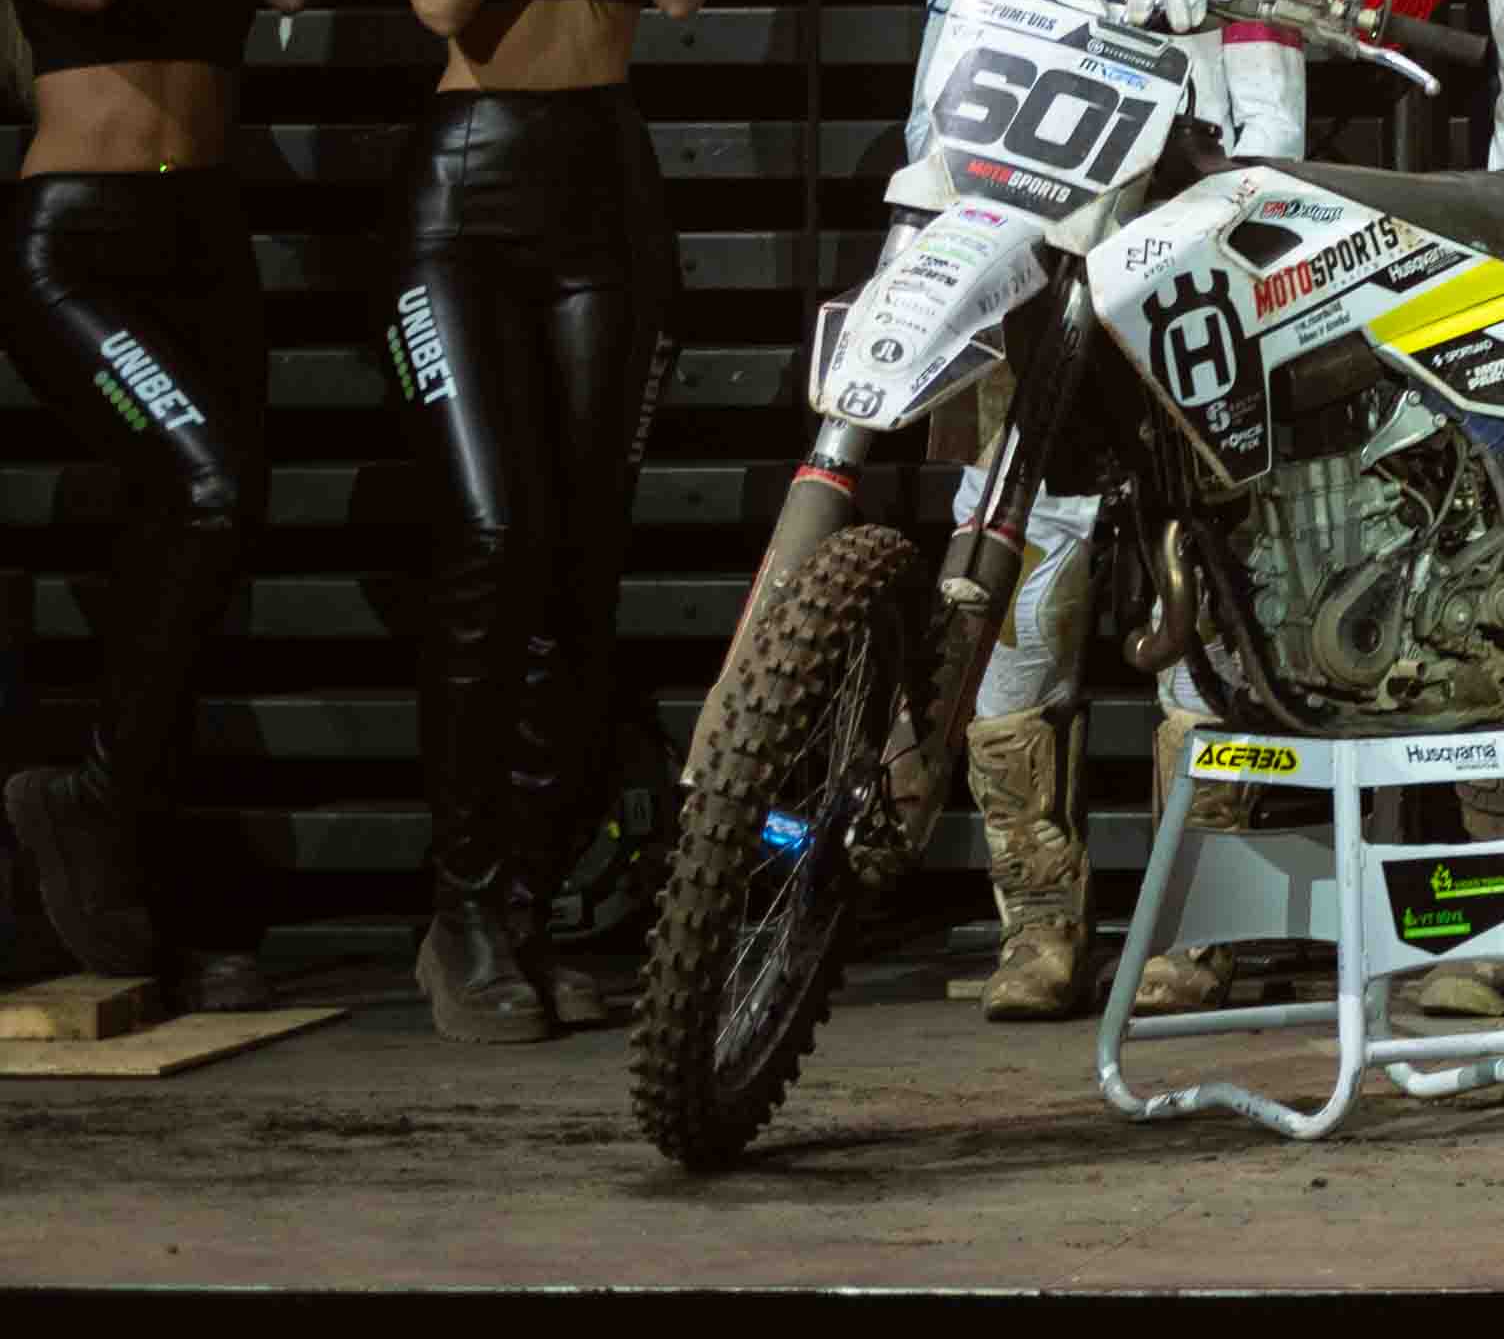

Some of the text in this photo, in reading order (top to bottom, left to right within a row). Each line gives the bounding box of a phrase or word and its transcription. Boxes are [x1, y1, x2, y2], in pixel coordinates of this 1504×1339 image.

[931, 47, 1159, 186] 601
[1252, 214, 1401, 320] MOTOSPORTS
[99, 329, 207, 432] UNIBET
[396, 284, 456, 407] UNIBET
[1195, 742, 1498, 771] ACERBIS Husqvarna
